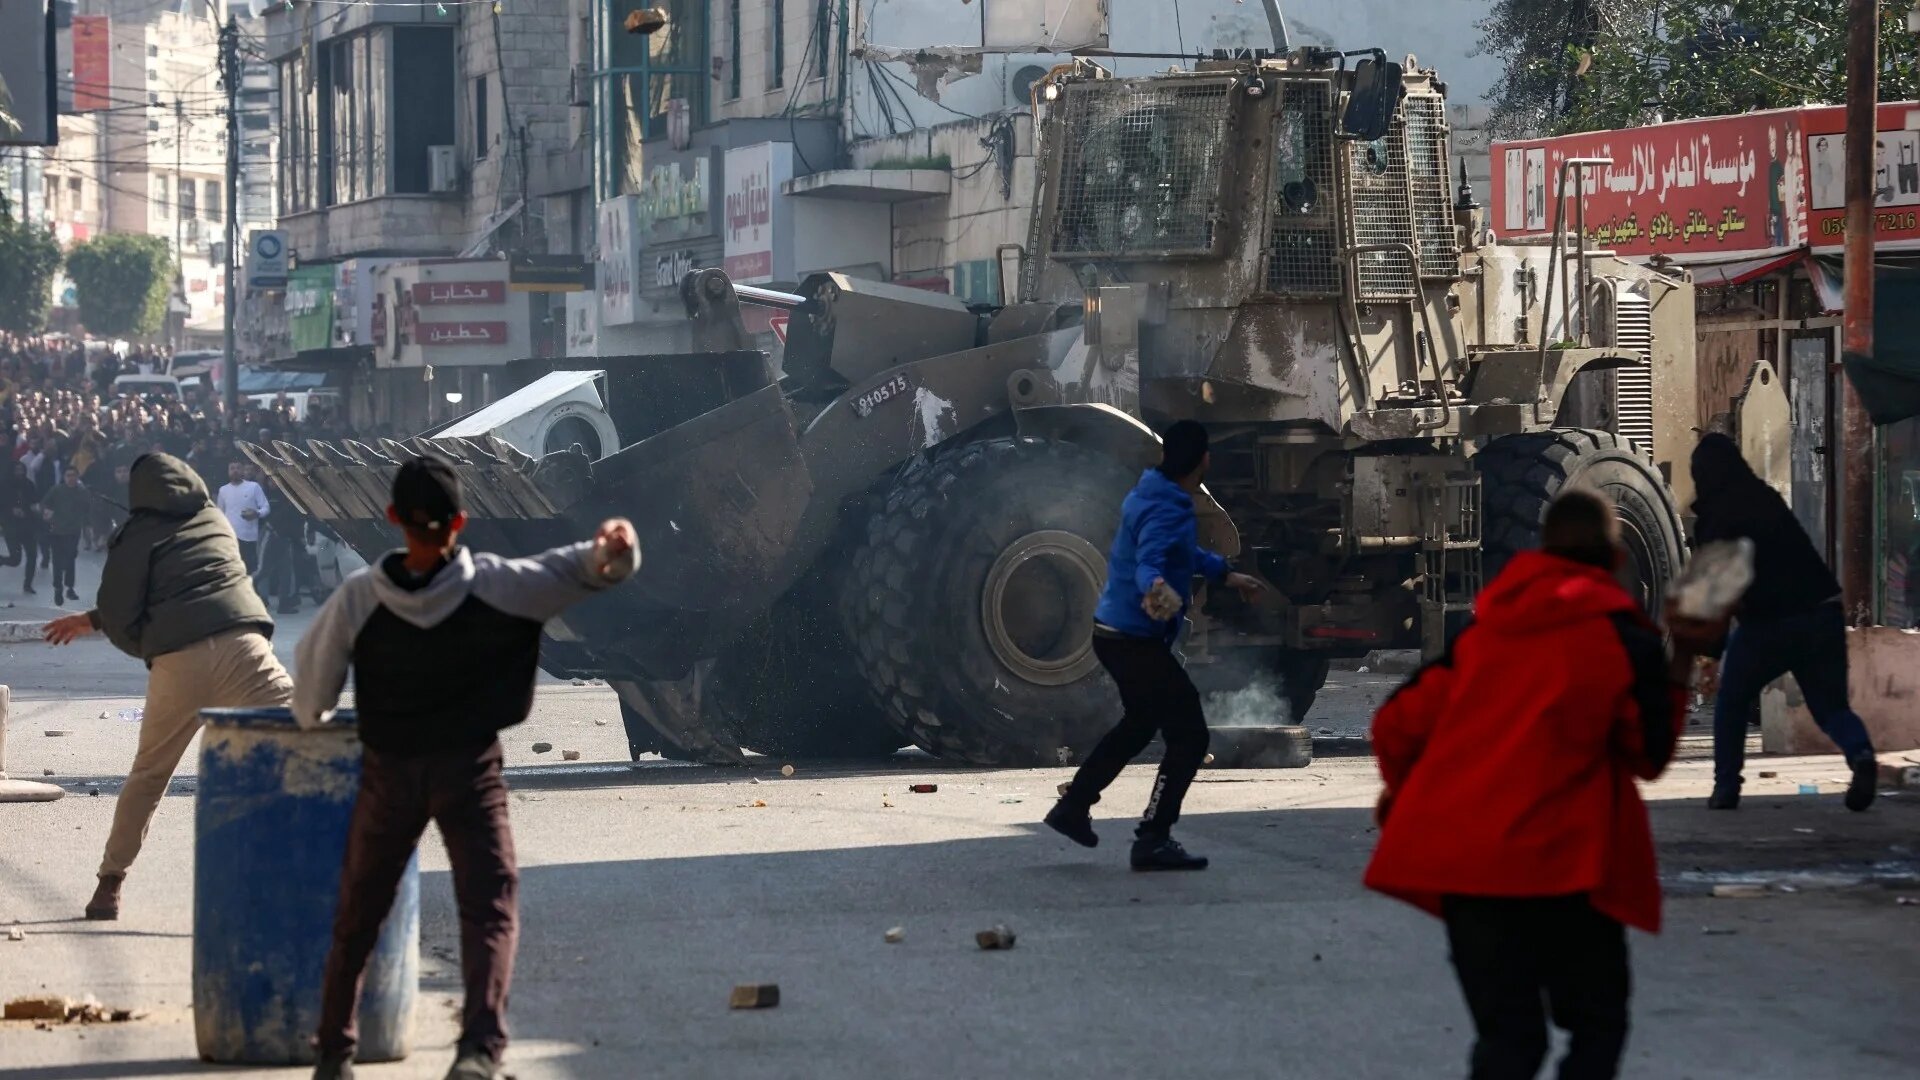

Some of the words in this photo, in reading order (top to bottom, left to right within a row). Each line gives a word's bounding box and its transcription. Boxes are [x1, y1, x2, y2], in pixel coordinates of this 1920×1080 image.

[1658, 137, 1700, 203] العامر
[1702, 133, 1756, 197] مؤسسة
[430, 284, 489, 304] مخابز
[430, 323, 490, 342] حطين
